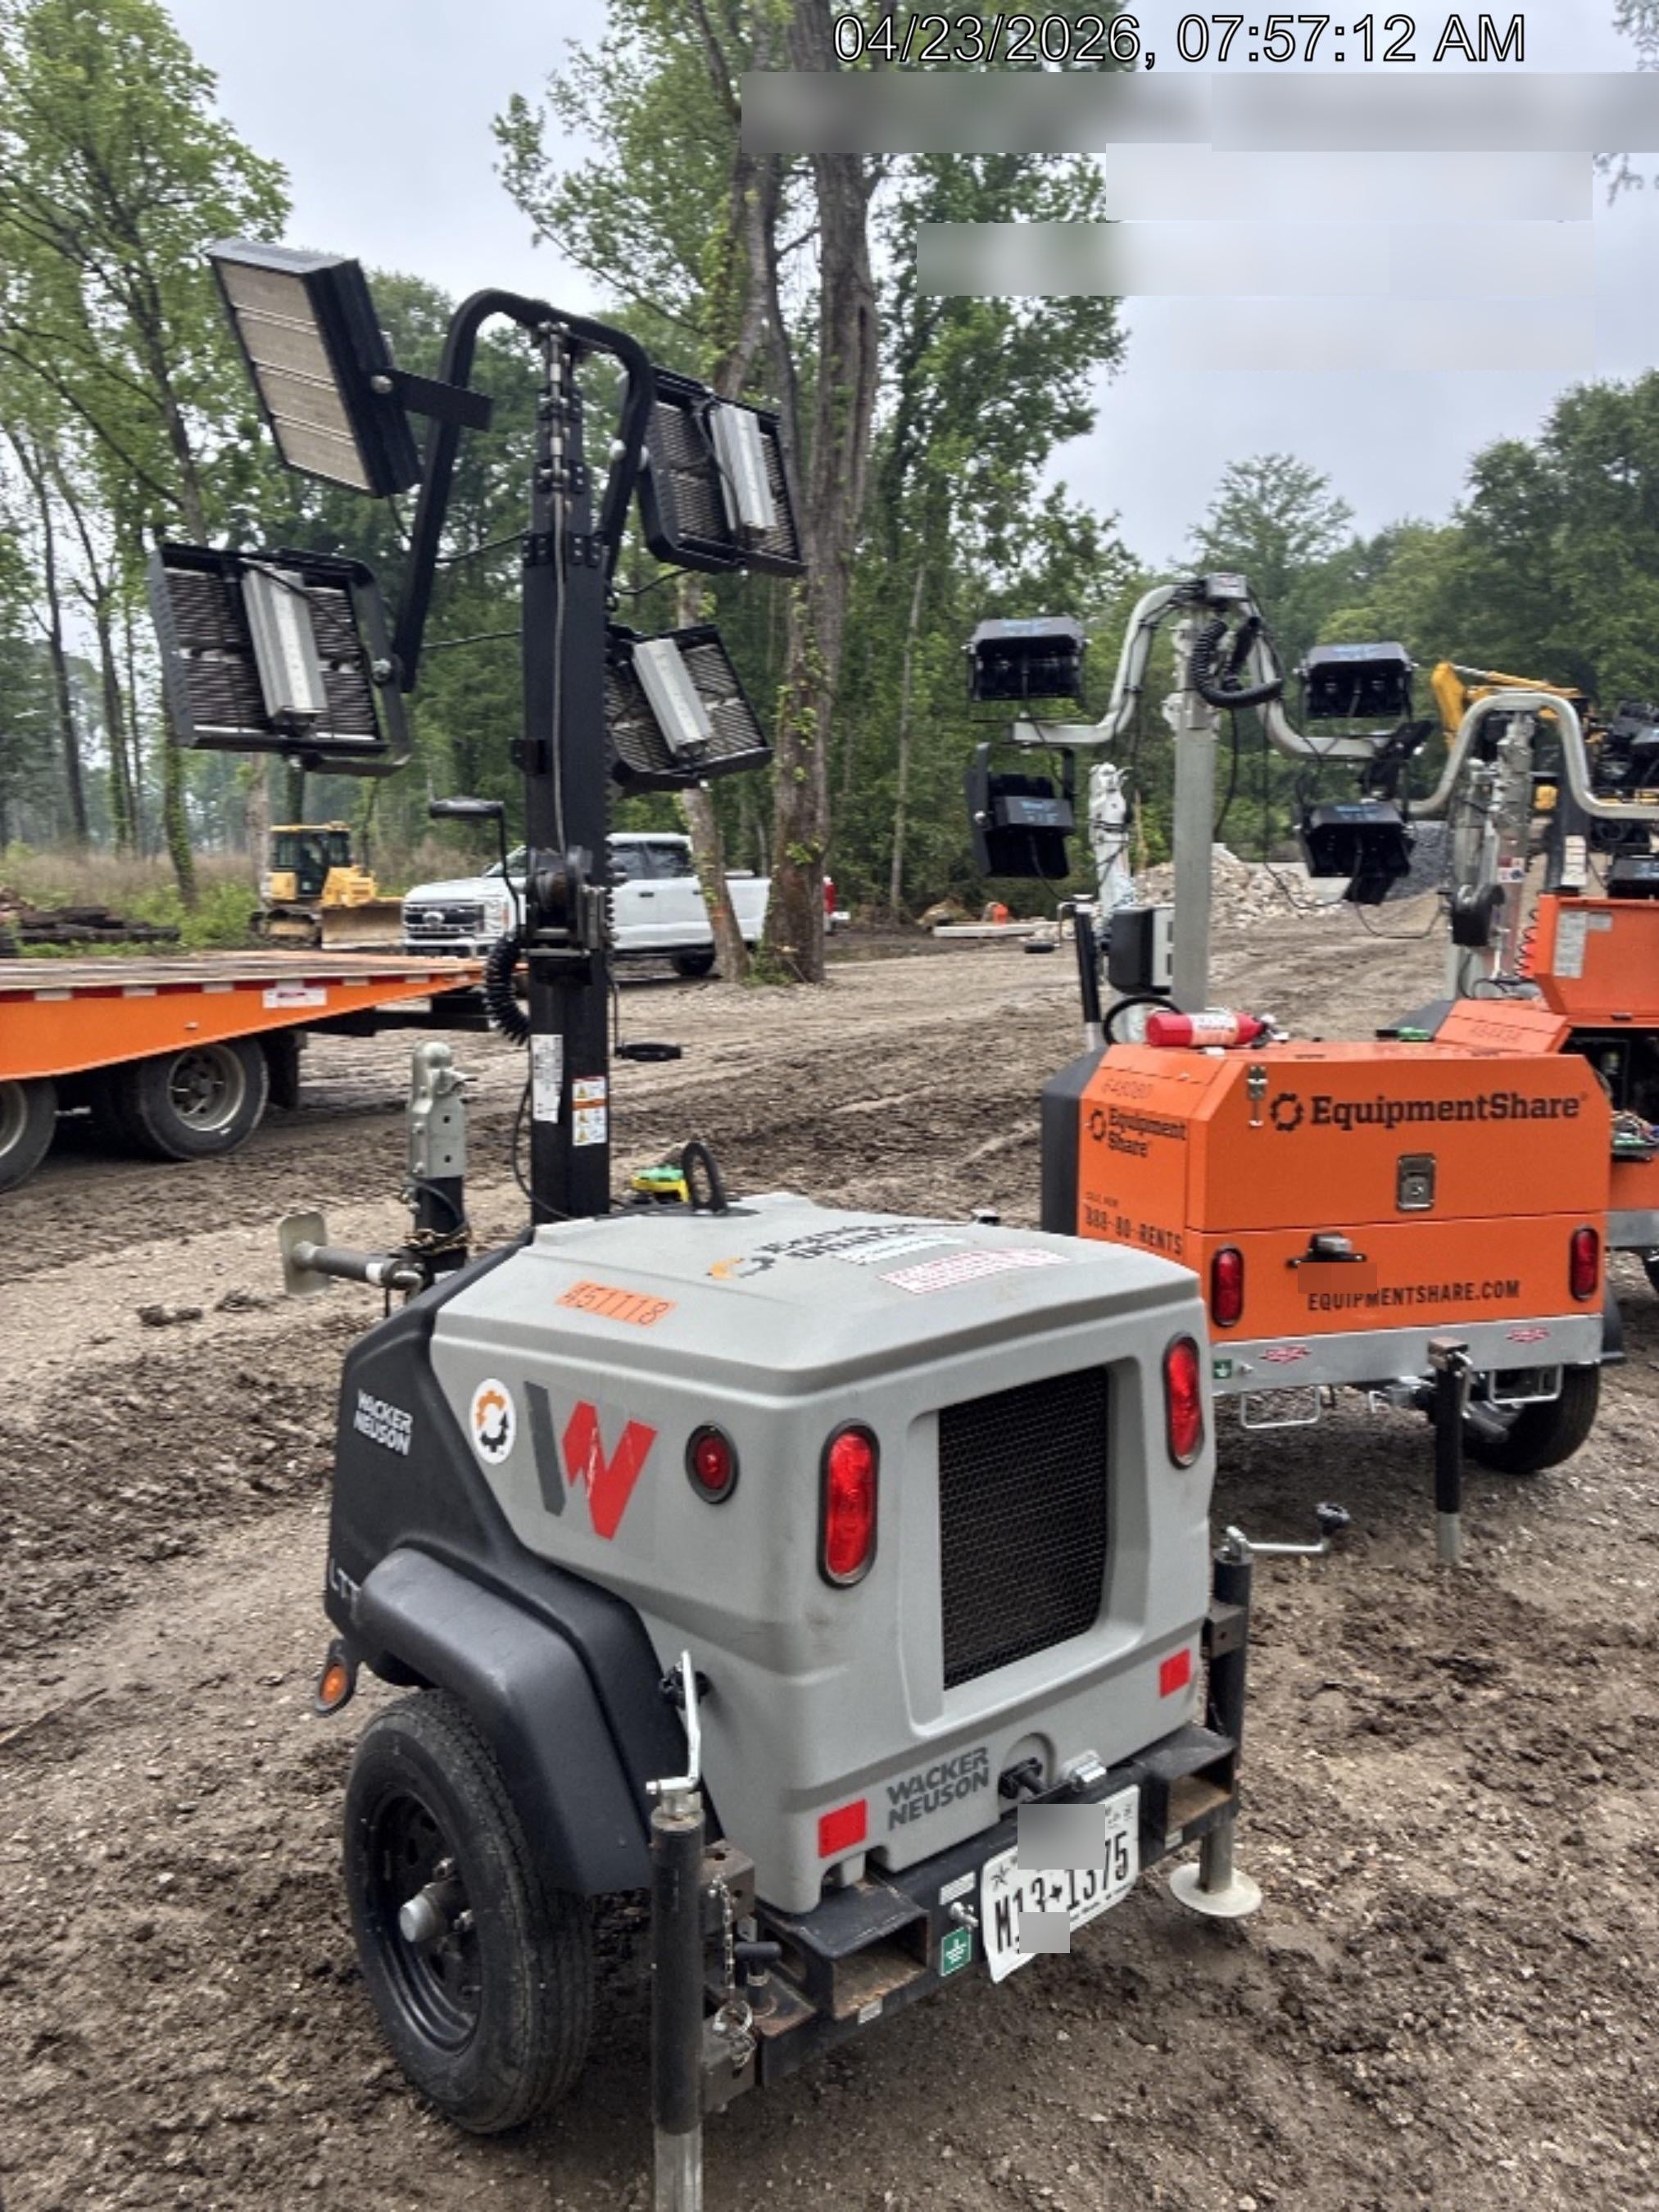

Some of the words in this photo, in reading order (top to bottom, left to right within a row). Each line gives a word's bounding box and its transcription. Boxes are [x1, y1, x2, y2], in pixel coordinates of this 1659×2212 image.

[1108, 1106, 1186, 1141] Equipment
[1310, 1092, 1580, 1131] EquipmentShare
[1108, 1129, 1148, 1158] Share
[1307, 1280, 1521, 1312] EQUIPMENTSHARE.COM
[353, 1408, 411, 1457] NEUSON
[357, 1387, 414, 1436] WACKER
[886, 1746, 989, 1806] WACKER
[888, 1766, 990, 1832] NEUSON
